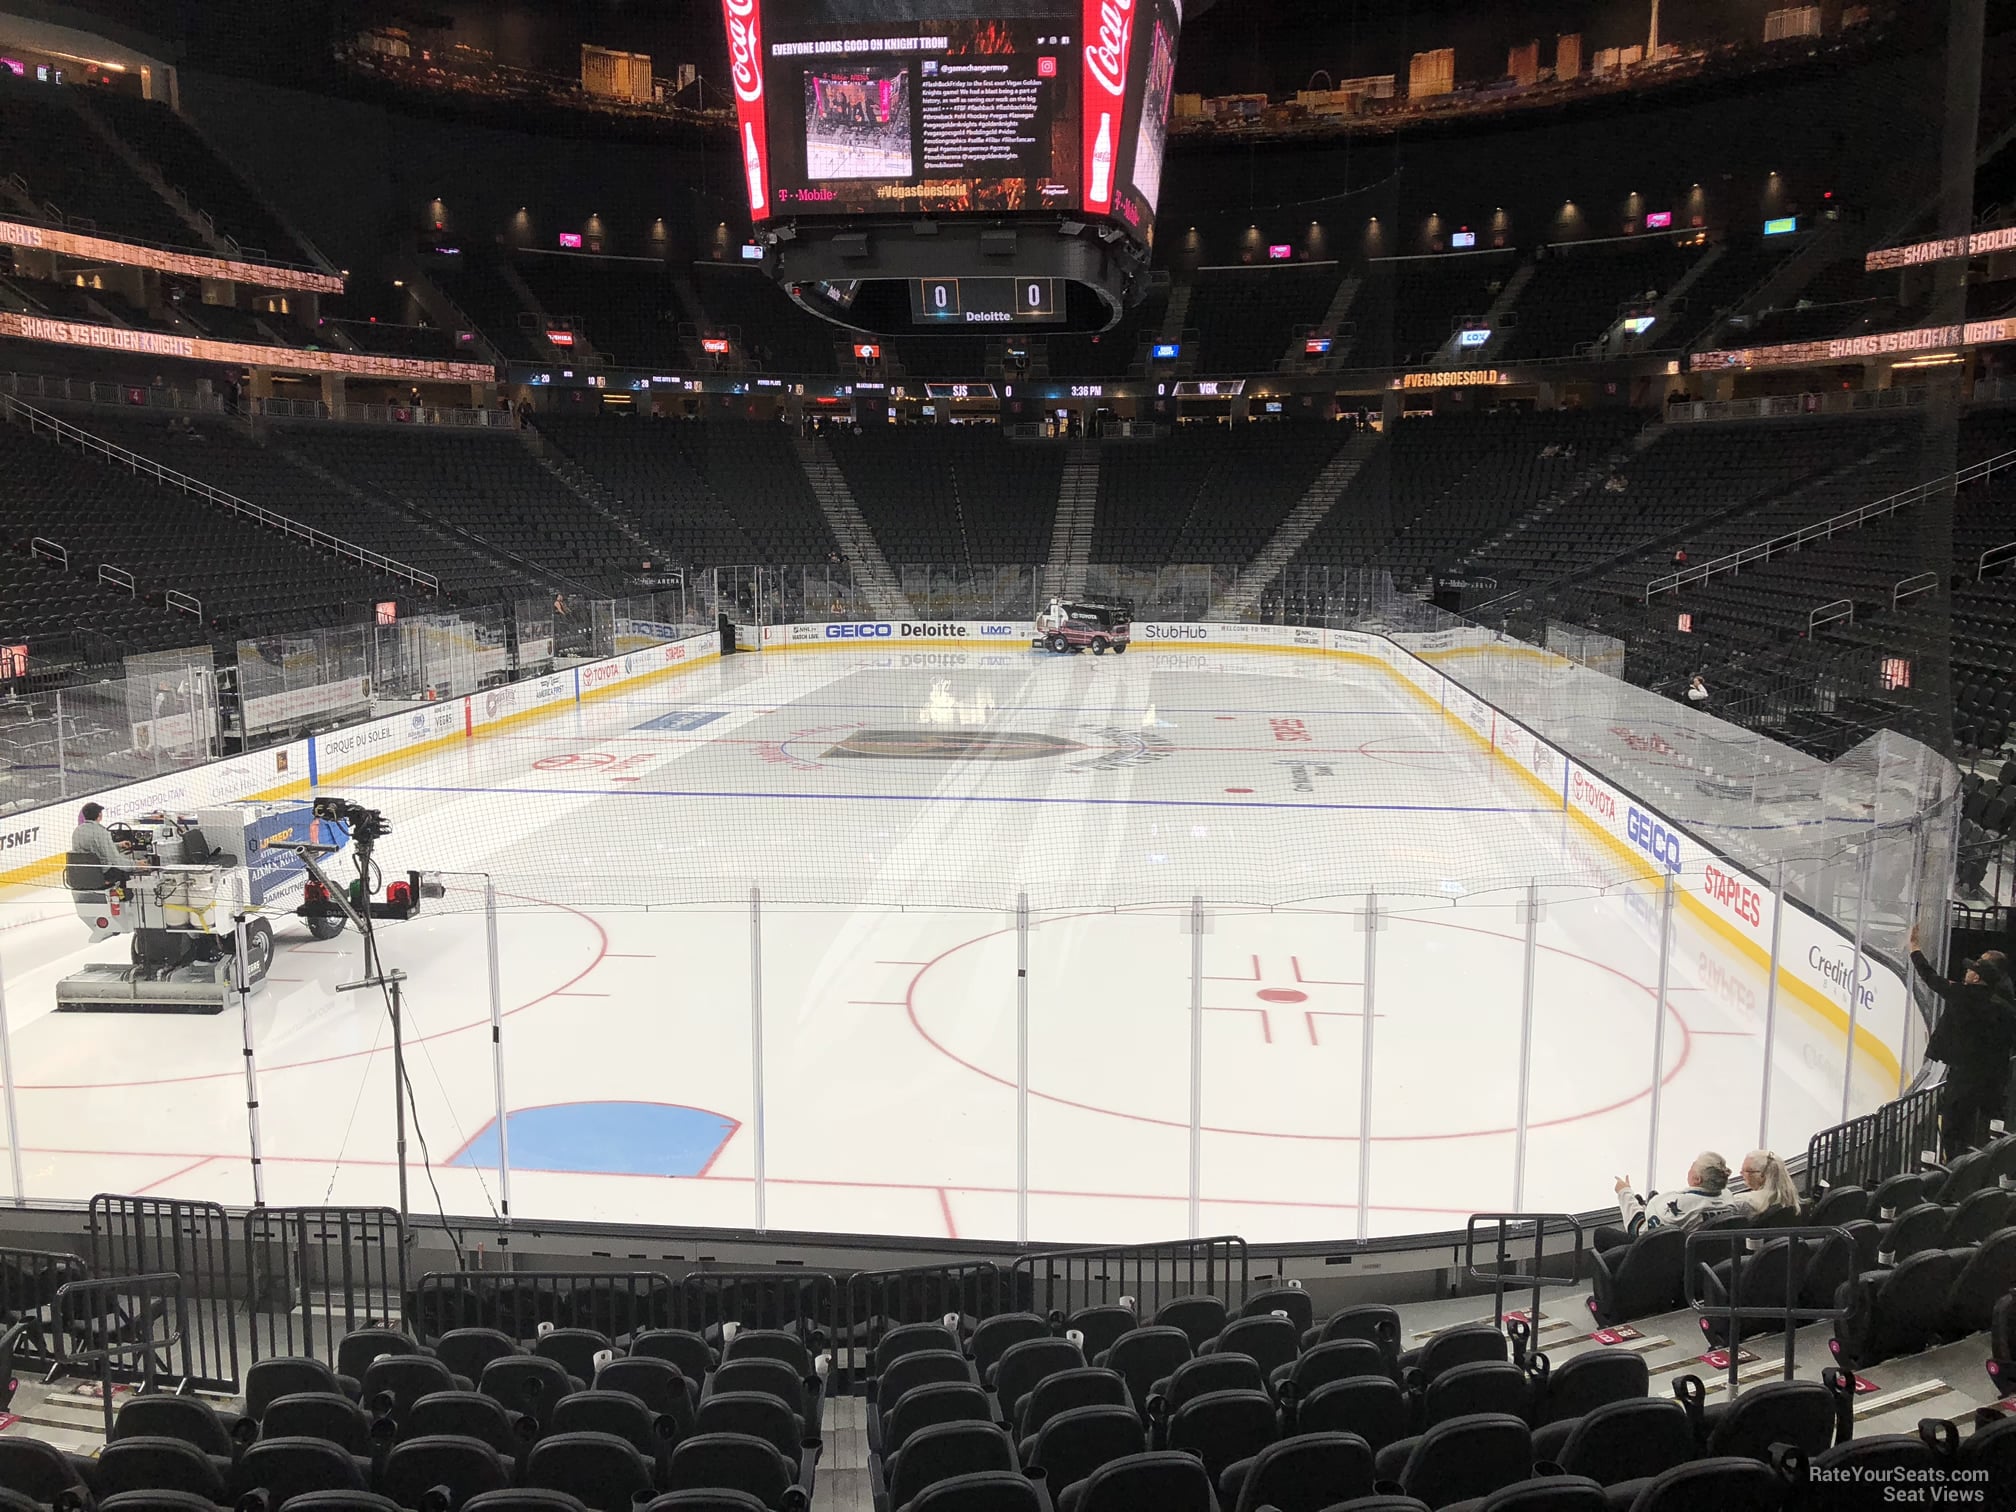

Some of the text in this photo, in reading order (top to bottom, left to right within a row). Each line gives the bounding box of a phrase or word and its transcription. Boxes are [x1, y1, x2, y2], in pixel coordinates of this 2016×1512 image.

[772, 36, 948, 56] EVERYONE LOOKS GOOD ON KNIGHT TRON!
[877, 184, 968, 199] #VegasGoesGold
[1903, 240, 1955, 264] SHARKS
[935, 285, 947, 308] 0
[1028, 284, 1040, 307] 0
[20, 316, 192, 356] SHARKS VS GOLDEN KNIGHTS
[1829, 335, 1877, 358] SHARKS
[1880, 333, 1898, 353] VS
[1899, 326, 1948, 351] GOLDEN
[1403, 369, 1497, 388] #VEGASGOESGOLD
[952, 385, 968, 397] SJS
[1071, 385, 1102, 397] 3:36 PM
[1199, 383, 1218, 395] VGK
[825, 623, 892, 638] GEICO
[980, 625, 1012, 635] UMC
[1145, 624, 1207, 639] StubHub
[665, 645, 686, 662] STAPLES
[593, 664, 619, 682] TOYOTA
[325, 736, 355, 755] CIRQUE
[355, 733, 367, 745] DU
[368, 728, 393, 742] SOLEIL
[106, 789, 185, 819] THE COSMOPOLITAN
[1583, 781, 1616, 822] TOYOTA
[1626, 806, 1682, 874] GEICO
[1704, 864, 1760, 928] STAPLES
